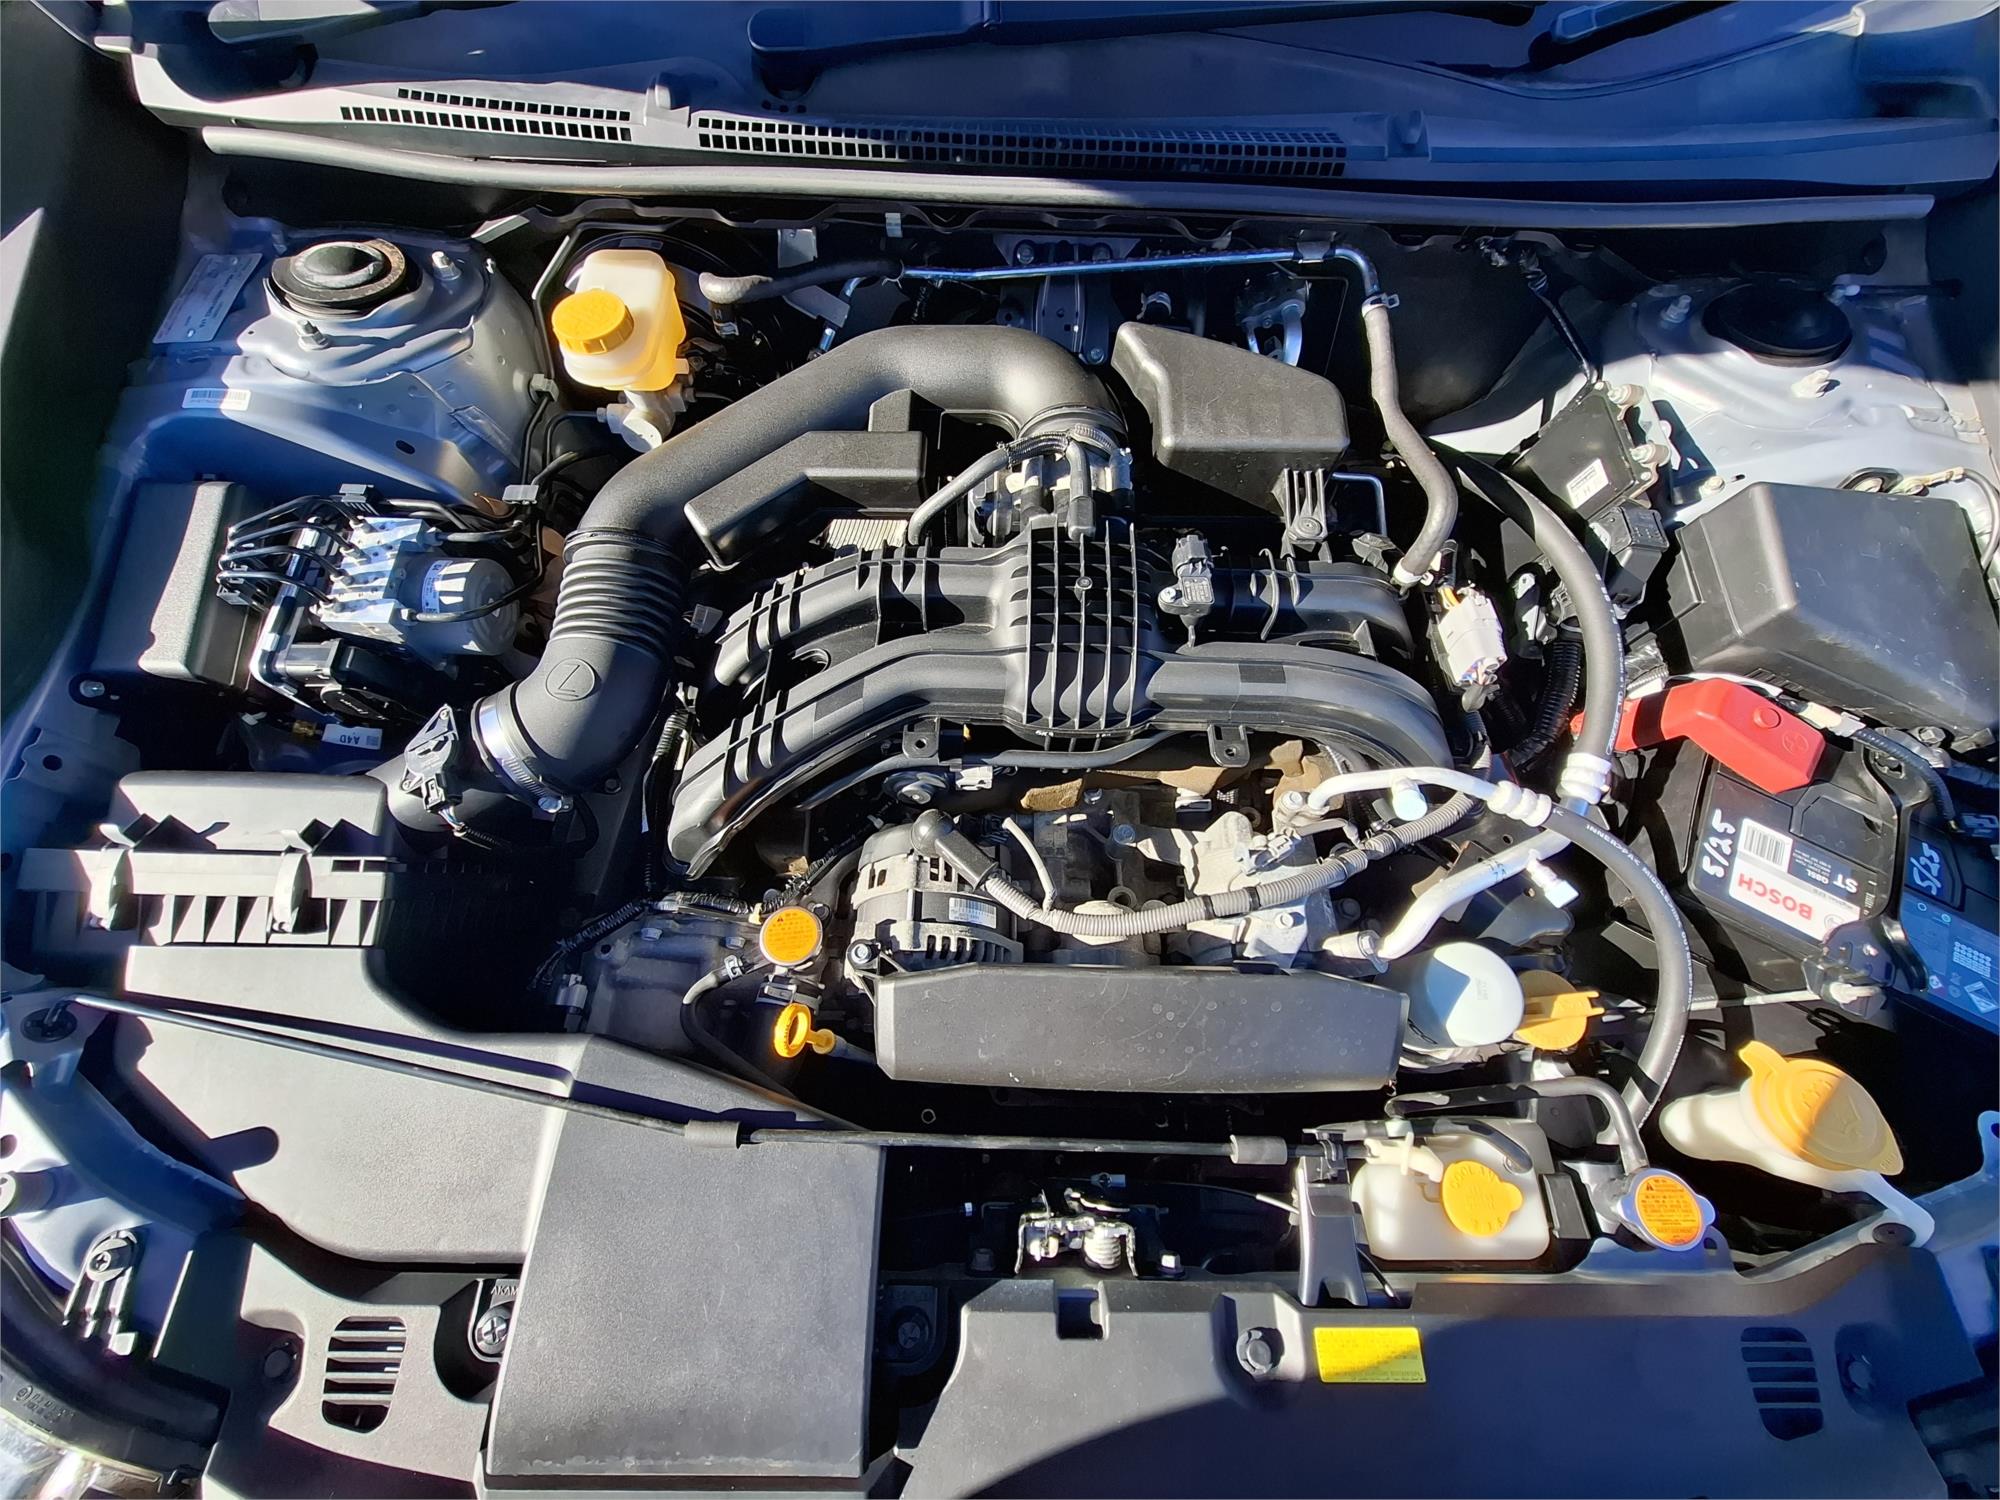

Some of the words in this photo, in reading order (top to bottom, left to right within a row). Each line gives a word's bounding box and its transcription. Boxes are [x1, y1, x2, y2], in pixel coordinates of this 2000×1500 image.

[339, 734, 361, 745] A4D
[1702, 808, 1736, 878] 5/25
[1833, 872, 1859, 894] ST
[1910, 841, 1941, 896] 5/25
[1738, 873, 1812, 921] BOSCH
